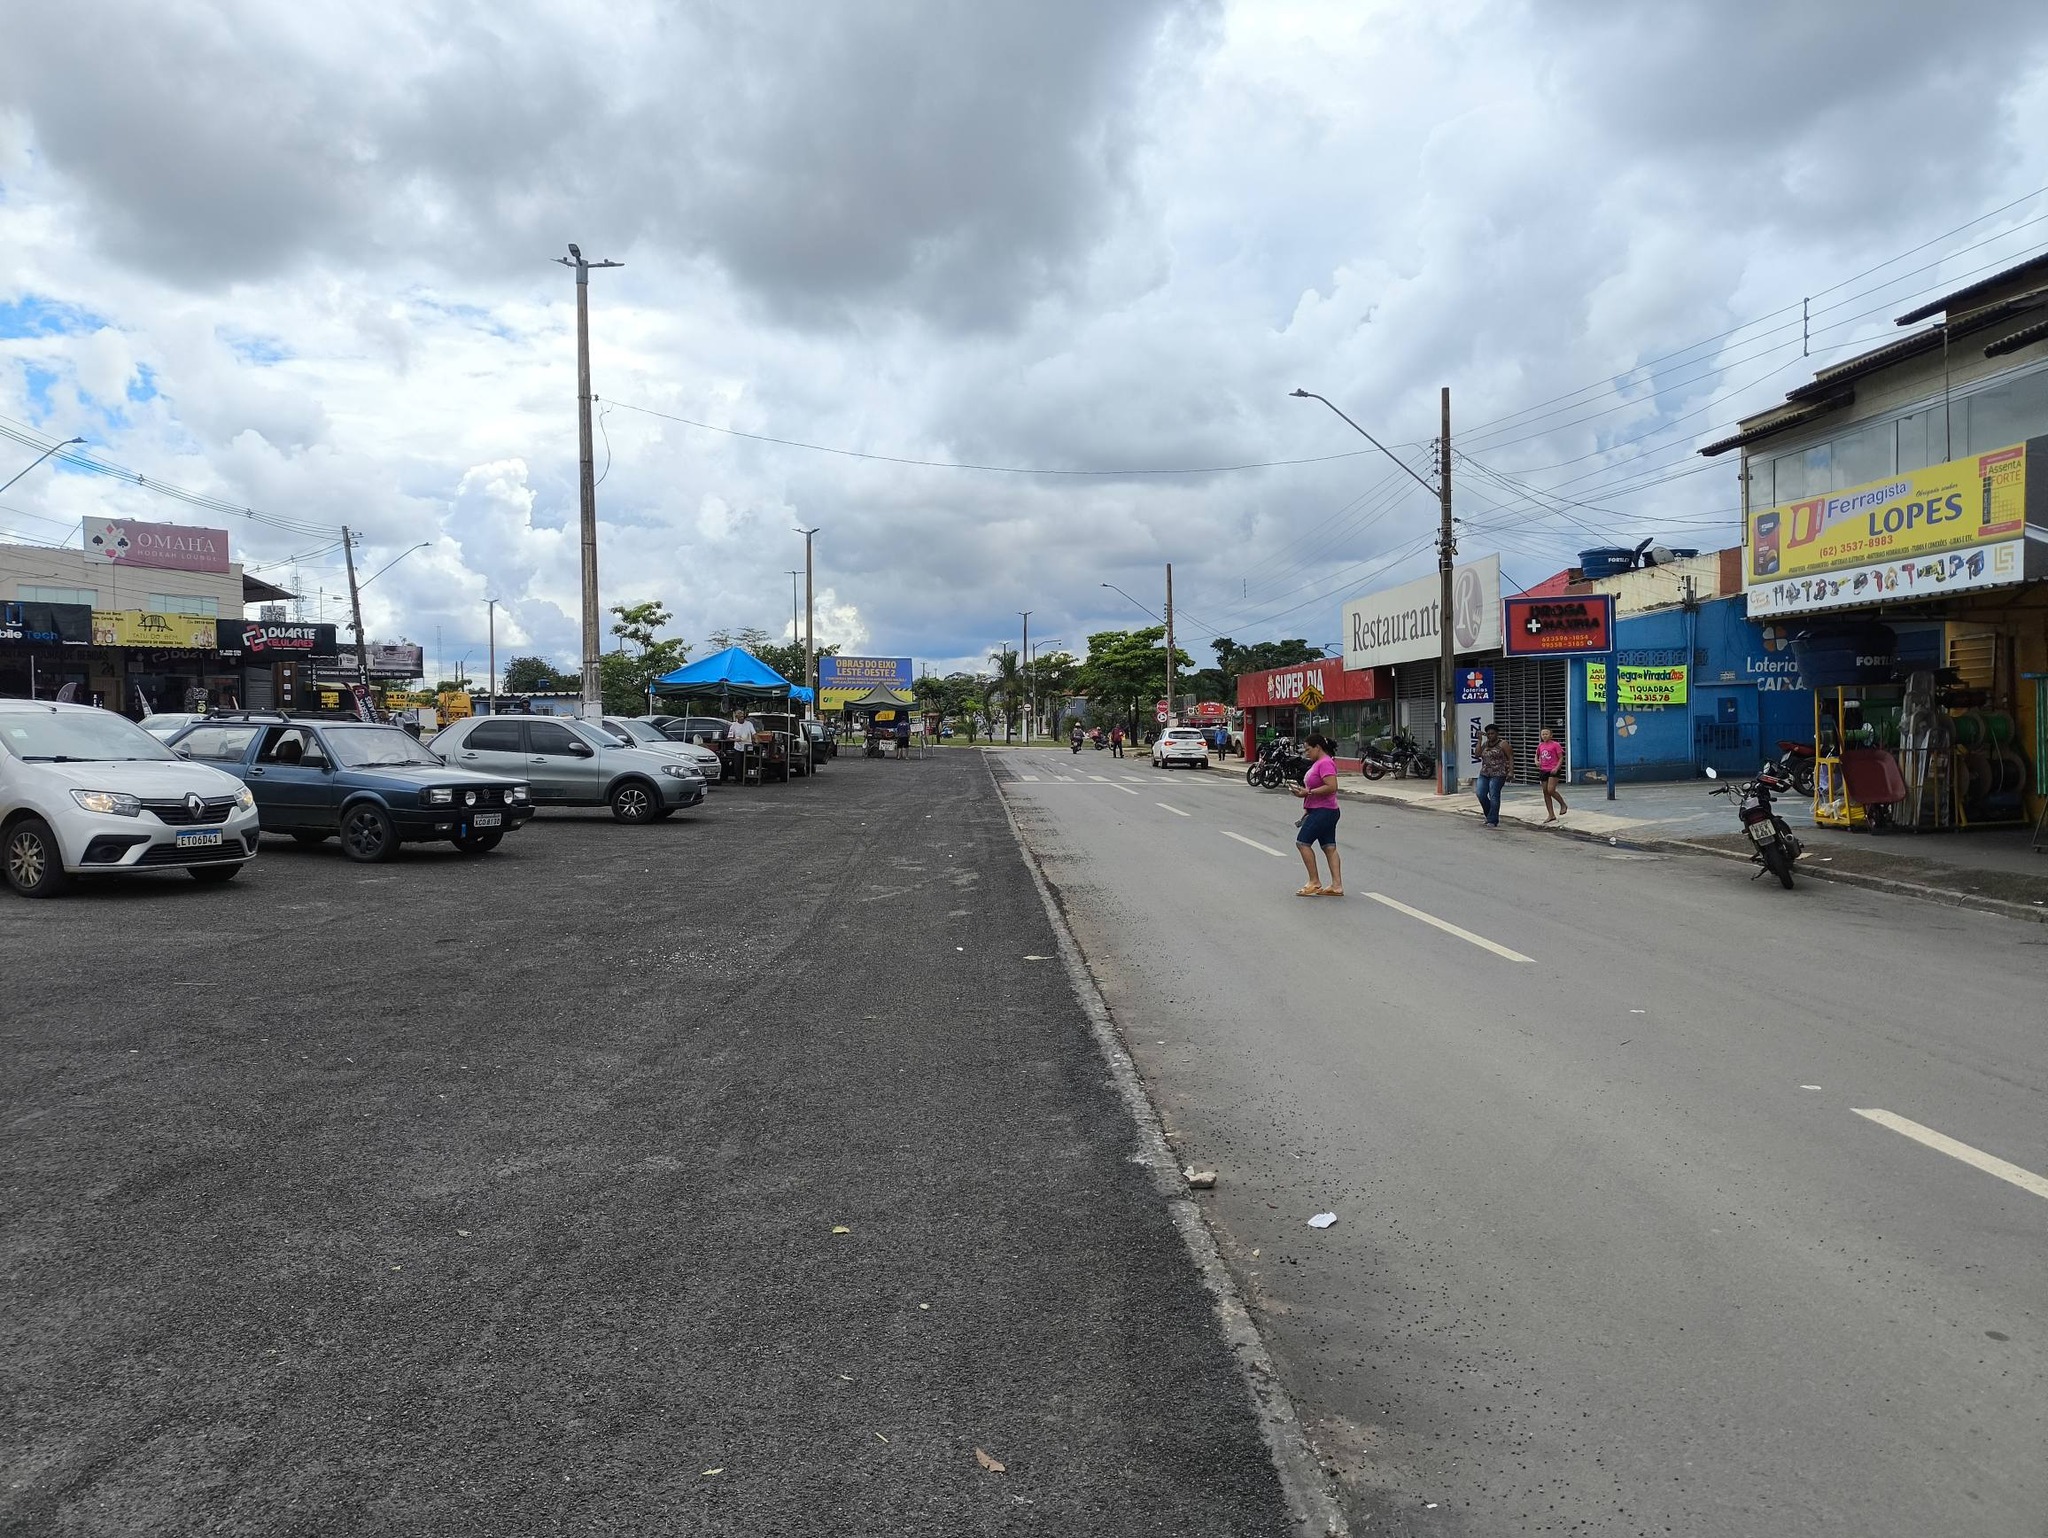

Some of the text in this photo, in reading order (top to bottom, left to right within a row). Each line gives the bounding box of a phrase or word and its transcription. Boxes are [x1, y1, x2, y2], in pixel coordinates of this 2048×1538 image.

[1991, 470, 2022, 485] FORTE
[1828, 483, 1906, 518] Ferragista
[1869, 493, 1963, 536] LOPES
[137, 533, 216, 553] OMAHA
[1820, 535, 1894, 559] (62) 3537-8983
[24, 630, 58, 639] Tech
[267, 626, 317, 639] DUARTE
[266, 639, 315, 648] CELULARES
[835, 659, 897, 669] OBRAS DO EIXO
[837, 668, 896, 677] LESTE-OESTE 2
[1643, 669, 1671, 681] Virada
[1275, 672, 1304, 699] SUPER
[1636, 685, 1675, 693] QUADRAS
[1757, 677, 1807, 692] CAIXA
[1462, 692, 1489, 700] CAIXA
